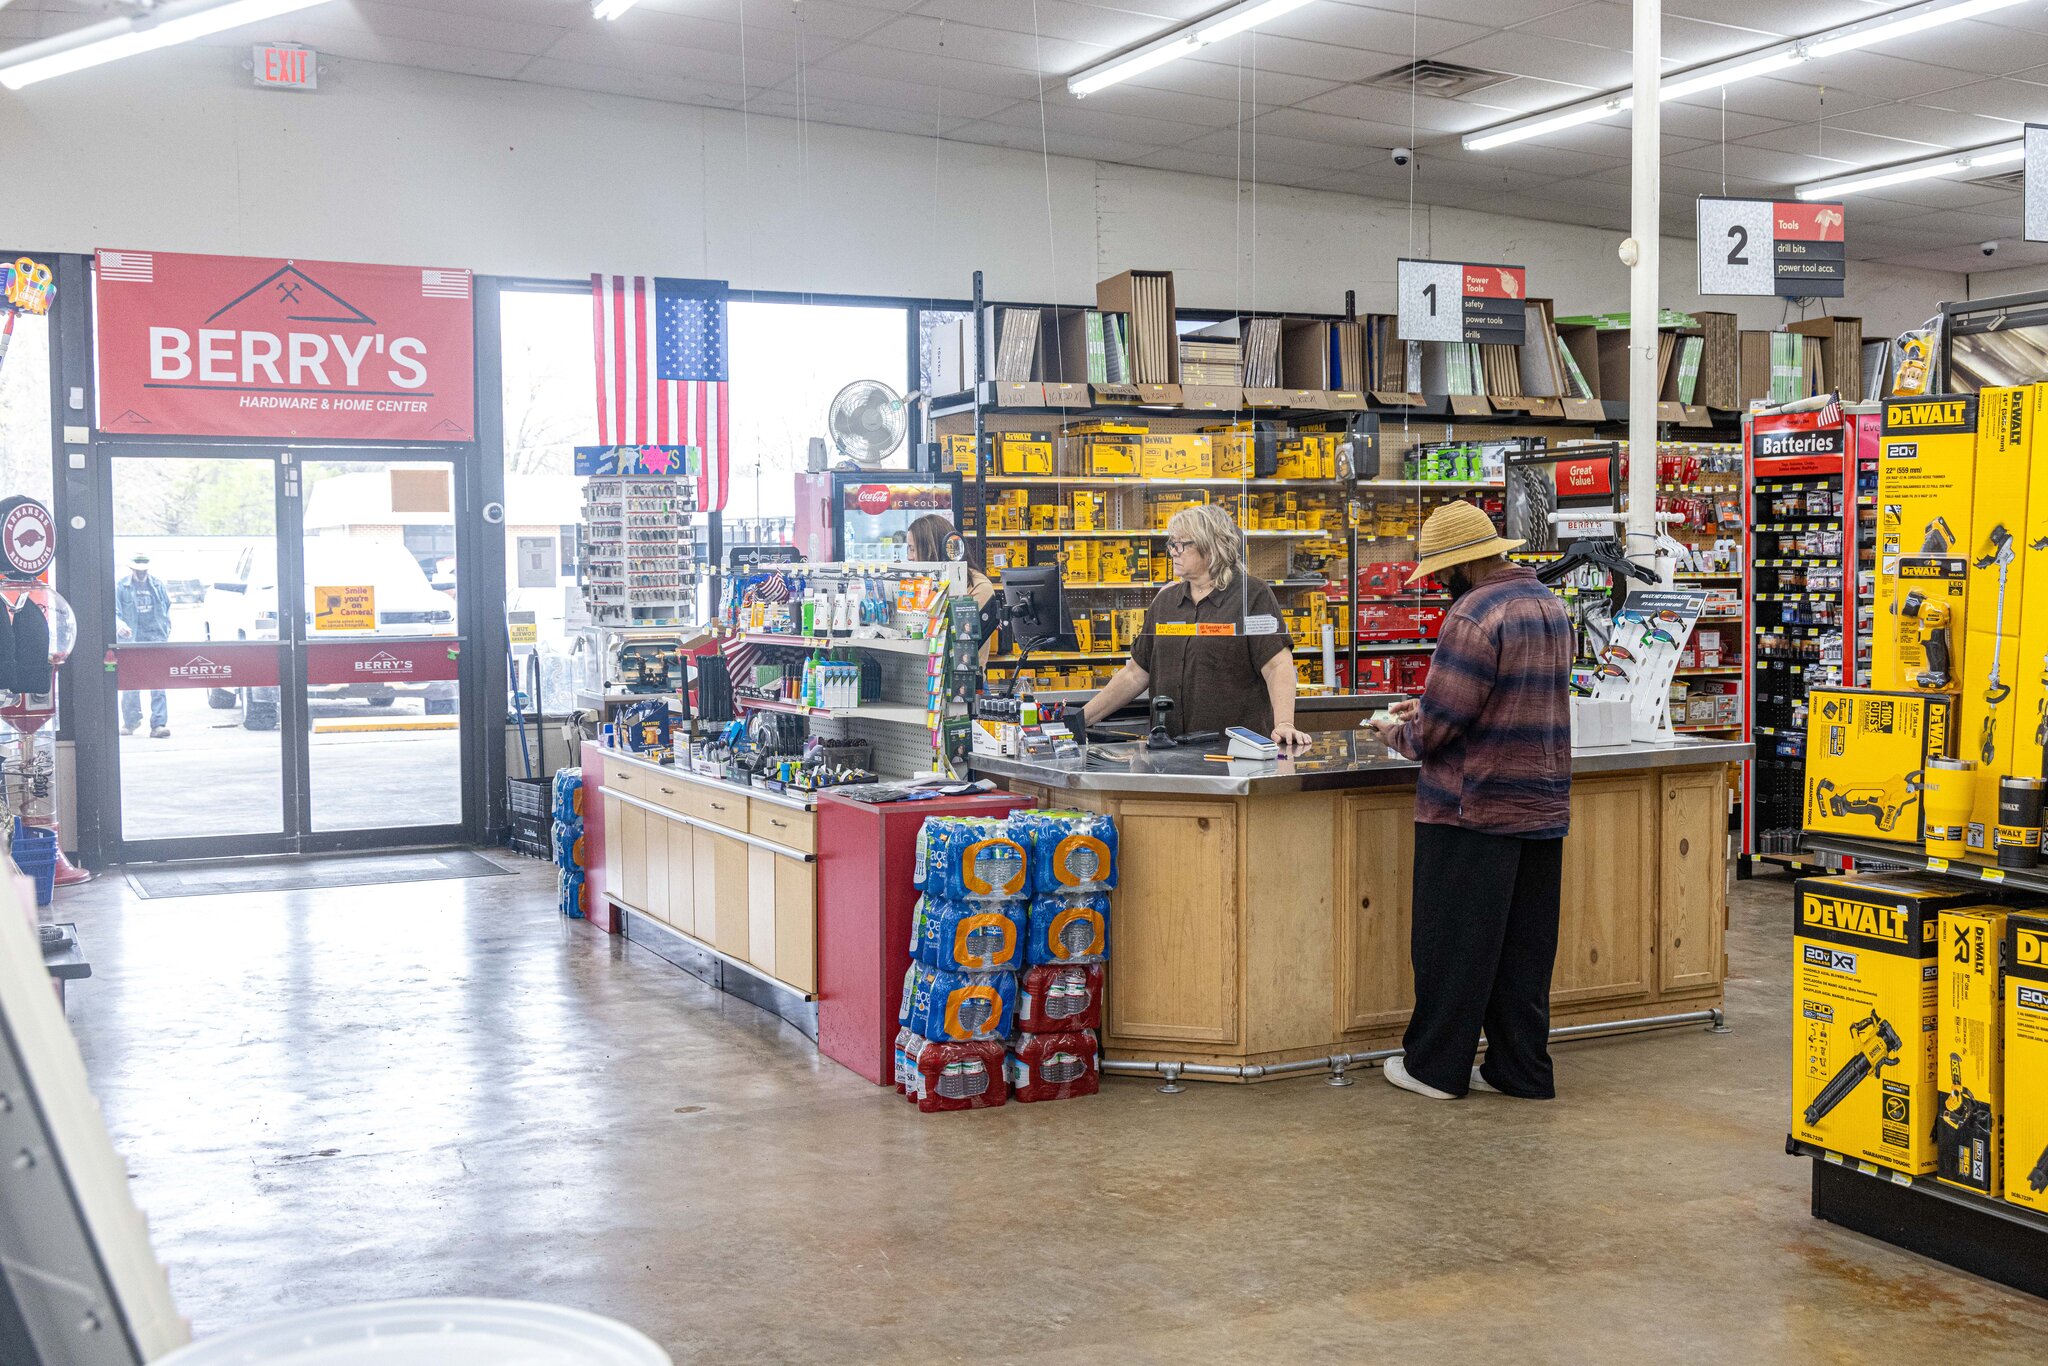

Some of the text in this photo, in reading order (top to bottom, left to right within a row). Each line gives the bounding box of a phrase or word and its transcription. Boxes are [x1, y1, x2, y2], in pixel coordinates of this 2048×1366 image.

[265, 49, 308, 84] EXIT
[1778, 220, 1799, 230] Tools
[1727, 225, 1749, 265] 2
[1777, 243, 1806, 253] drill bits
[1778, 263, 1835, 274] power tool accs.
[1466, 275, 1489, 284] Power
[1466, 284, 1485, 293] Tools
[1422, 283, 1436, 316] 1
[1464, 300, 1485, 310] safety
[1465, 316, 1503, 325] power tools
[1465, 330, 1481, 339] drills
[149, 326, 428, 389] BERRY'S
[239, 395, 428, 413] HARDWARE & HOME CENTER
[1888, 404, 1966, 425] DEWALT
[2010, 392, 2024, 445] DEWALT
[1005, 433, 1032, 441] DEWALT
[1763, 434, 1834, 455] Batteries
[1569, 465, 1593, 475] Great
[1910, 466, 1922, 474] mm)
[1569, 475, 1595, 487] Value!
[858, 490, 888, 502] Coca-Cola
[7, 506, 50, 531] ARKANSAS
[9, 546, 52, 570] RAZORBACKS
[1902, 567, 1941, 576] DEWALT
[344, 595, 369, 603] you're
[169, 665, 232, 675] BERRY'S
[354, 660, 413, 670] BERRY'S
[1870, 701, 1880, 726] CUTS
[1881, 704, 1893, 725] 1100
[1930, 704, 1946, 757] DEWAL
[1883, 808, 1893, 824] DEWALT
[1804, 896, 1908, 940] DEWALT
[1954, 924, 1970, 963] XR
[1975, 927, 1985, 976] DEWALT
[1806, 957, 1831, 967] BRUSHLESS
[1833, 953, 1854, 971] XR
[1924, 967, 1938, 977] 20
[1803, 977, 1822, 985] SOPLADORA
[1803, 987, 1821, 995] SOUFFLEUR
[1855, 997, 1873, 1006] seulement)
[1862, 1149, 1893, 1163] GUARANTEED
[1975, 1162, 1982, 1179] XR
